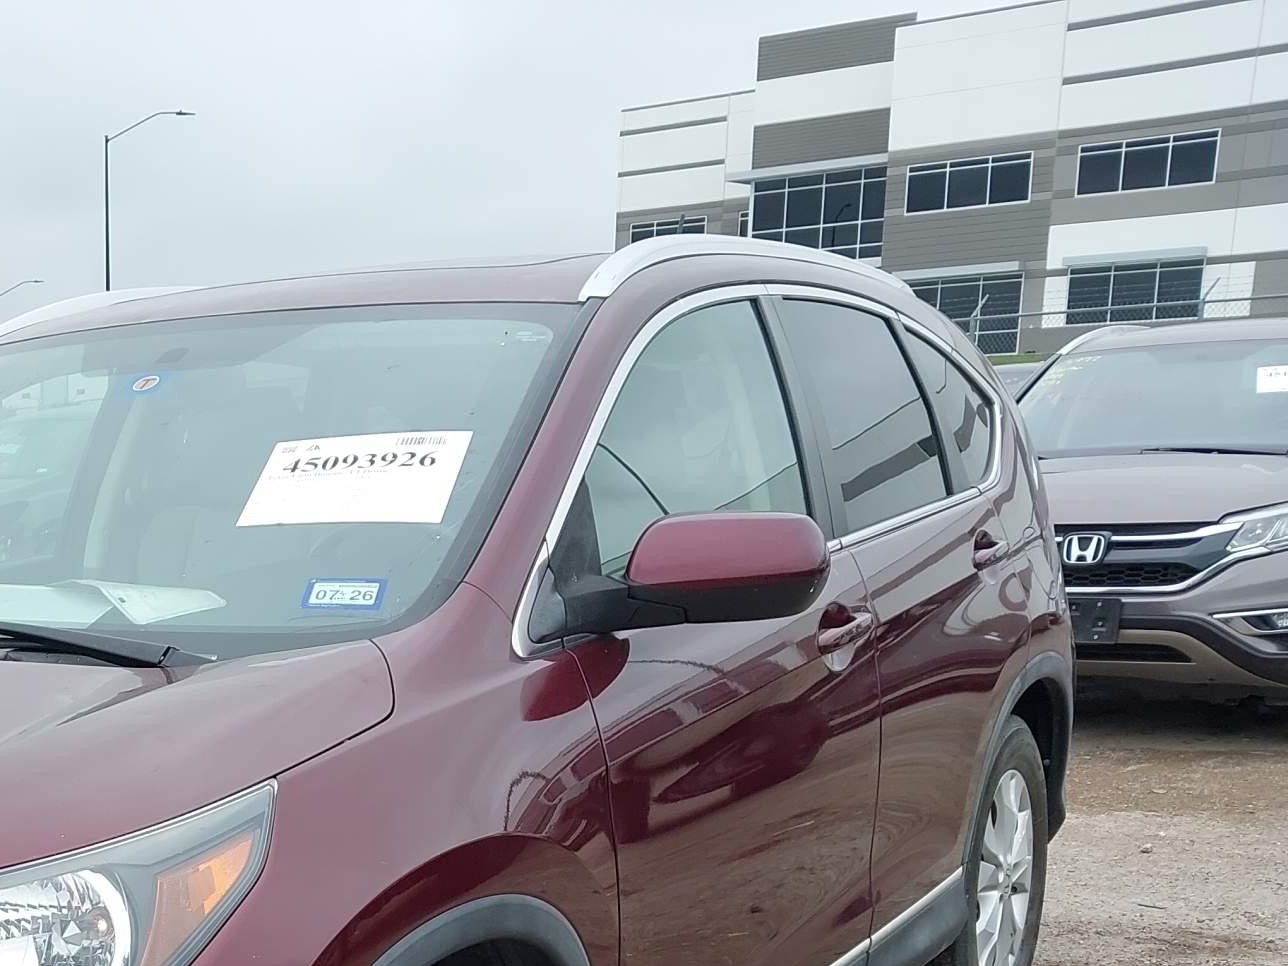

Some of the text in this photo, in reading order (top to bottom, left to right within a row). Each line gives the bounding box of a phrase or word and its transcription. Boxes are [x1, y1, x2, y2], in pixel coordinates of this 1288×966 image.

[282, 451, 439, 473] 45093926
[315, 589, 375, 601] 07 26
